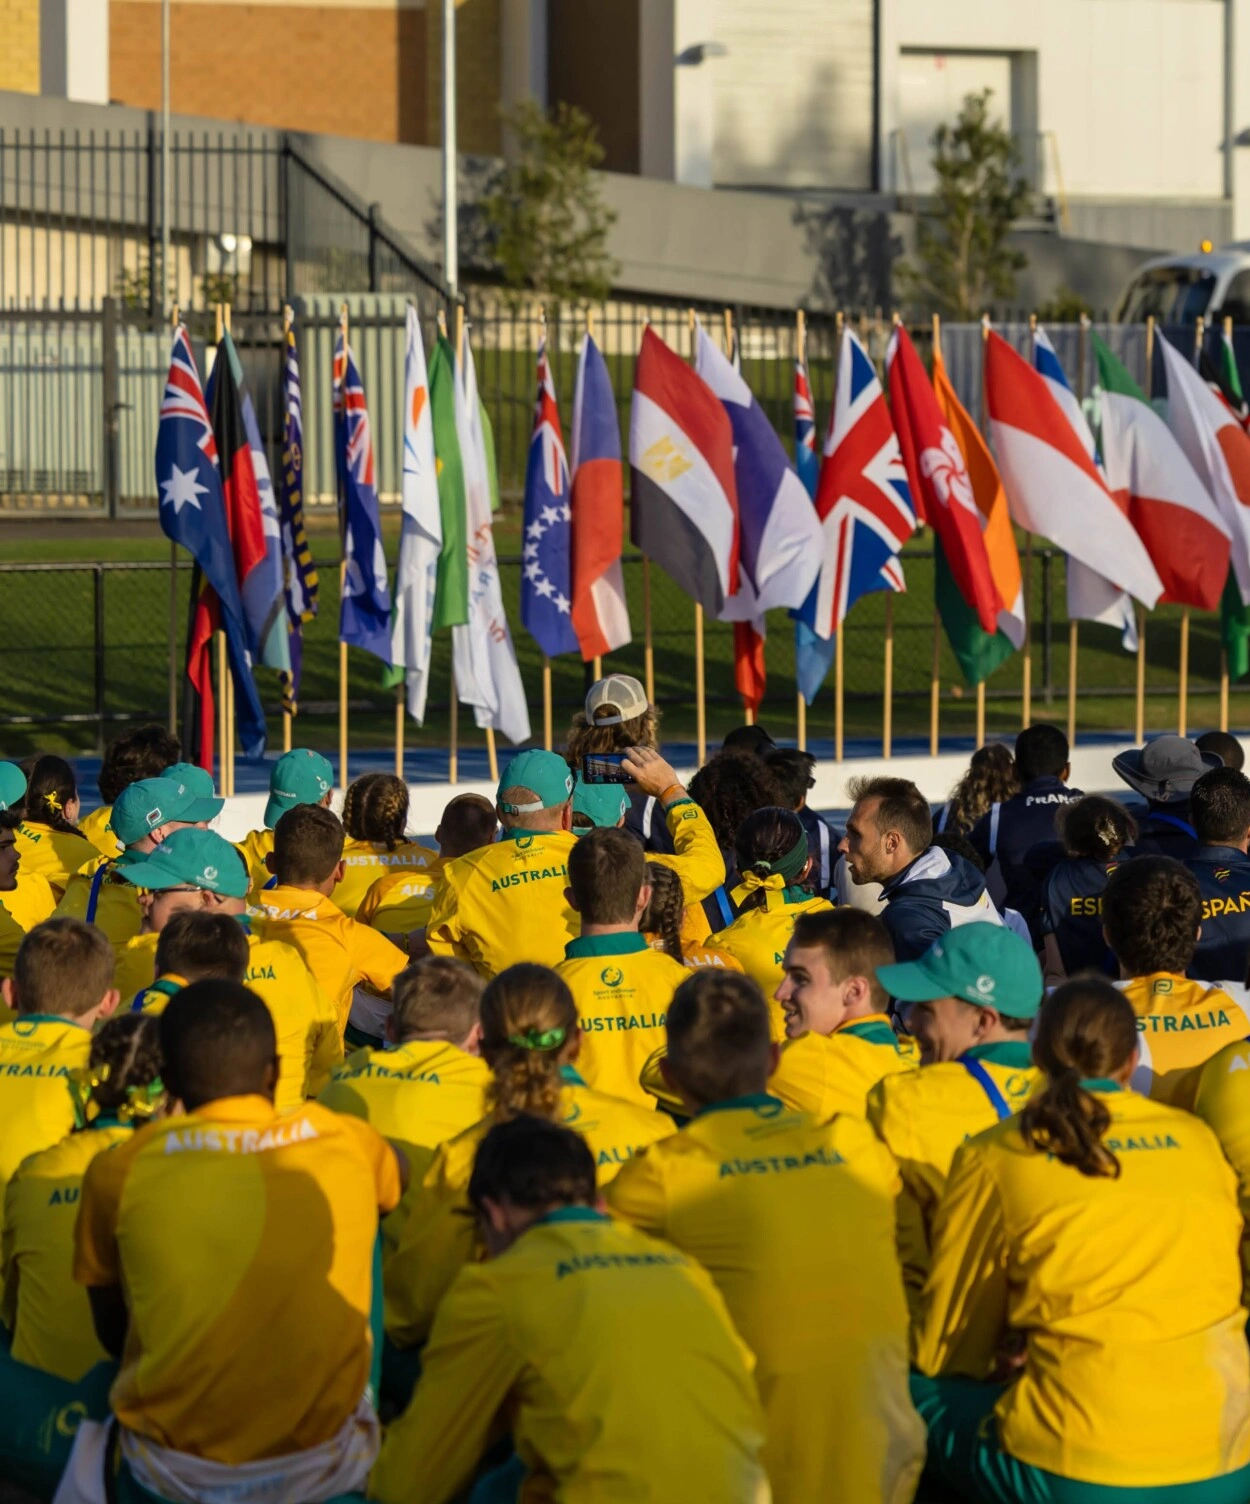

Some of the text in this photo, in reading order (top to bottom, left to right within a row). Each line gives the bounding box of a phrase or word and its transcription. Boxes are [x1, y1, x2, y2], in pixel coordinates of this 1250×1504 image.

[1026, 793, 1084, 806] FRANC
[346, 855, 427, 867] USTRALIA
[491, 864, 567, 892] AUSTRALI
[581, 1013, 667, 1032] USTRALIA
[1136, 1010, 1231, 1032] STRALIA
[164, 1119, 319, 1155] AUSTRALIA
